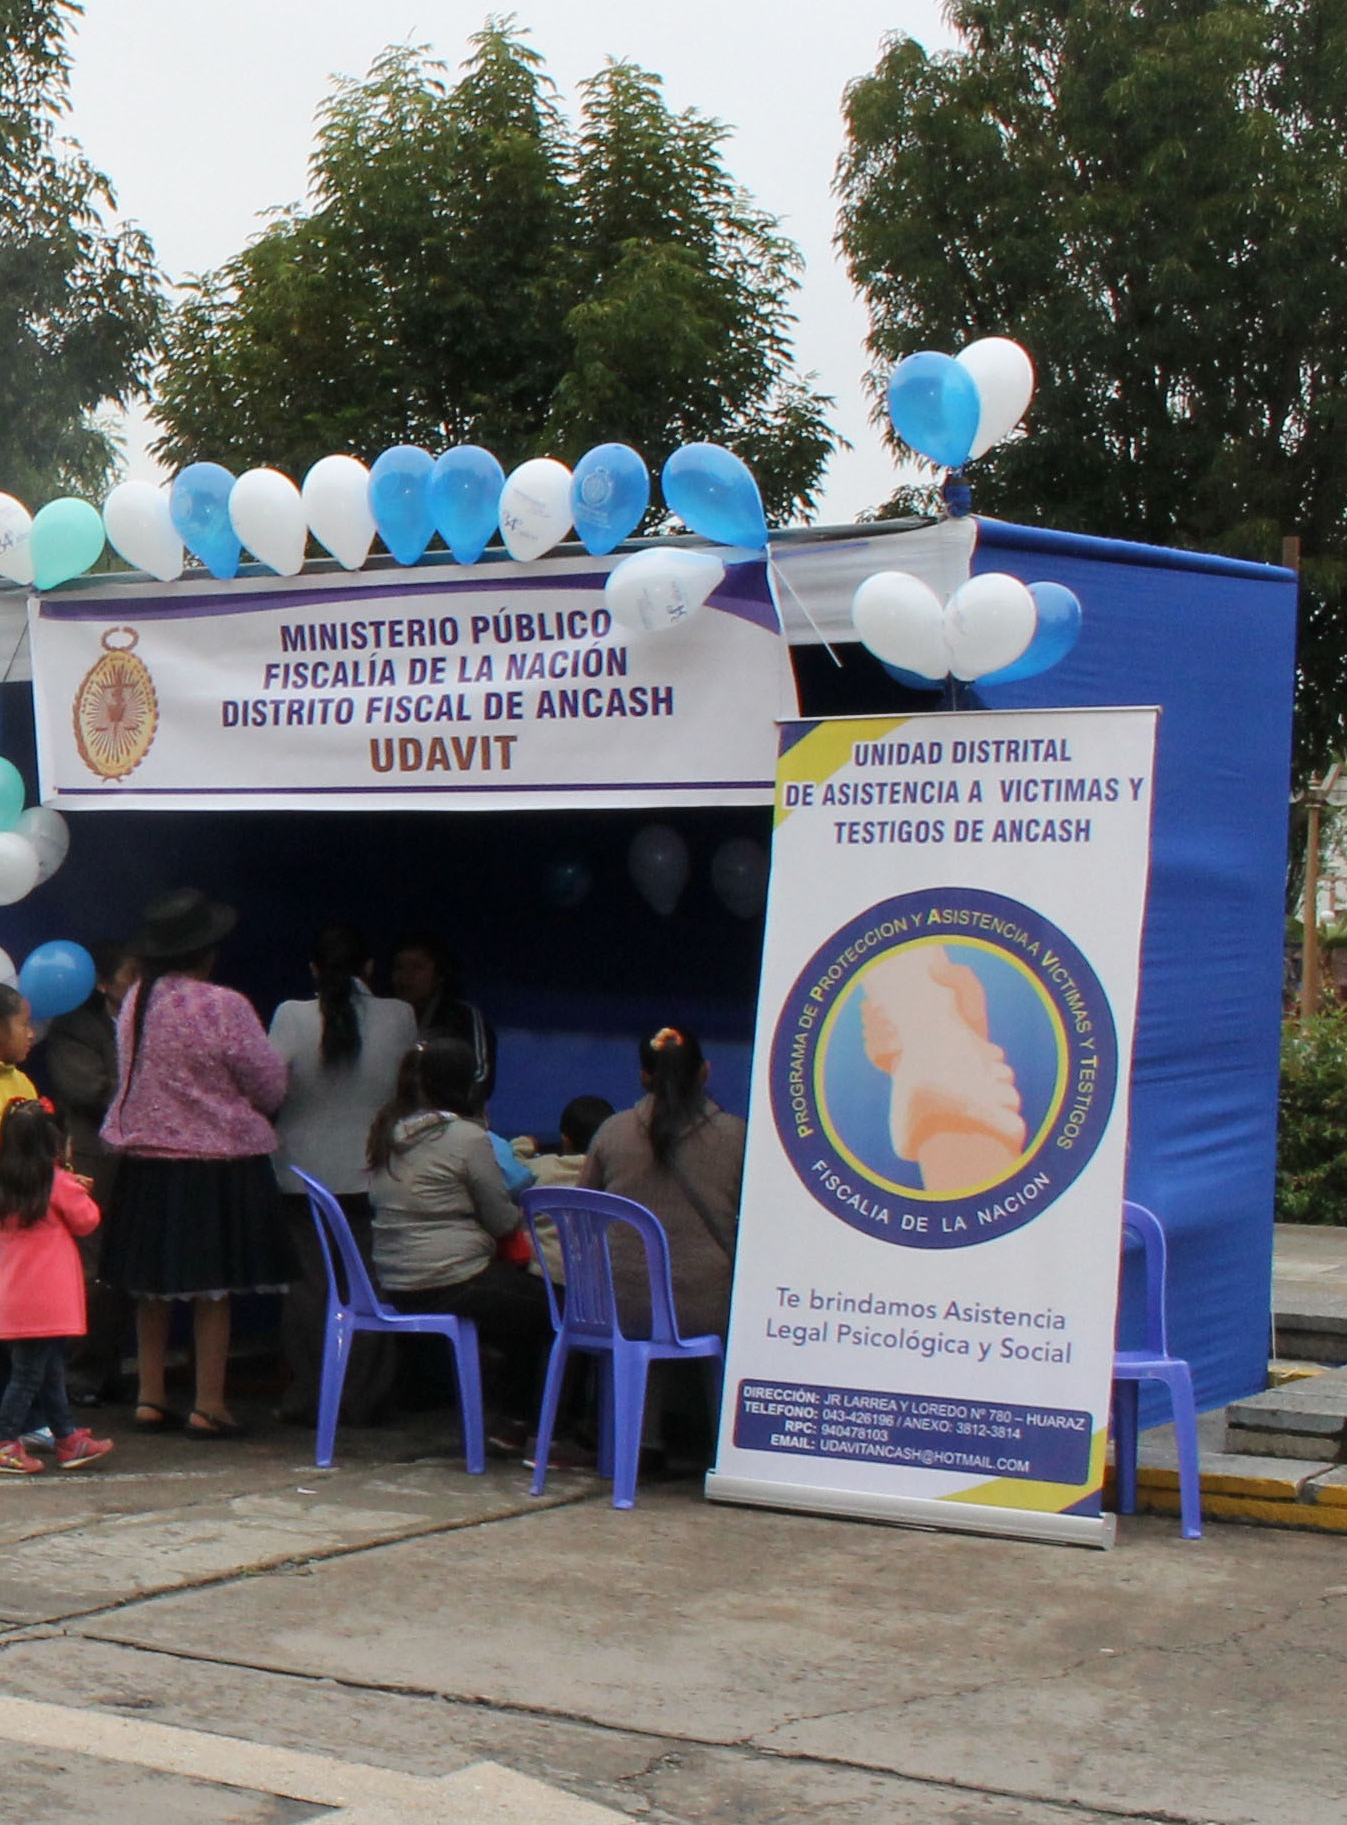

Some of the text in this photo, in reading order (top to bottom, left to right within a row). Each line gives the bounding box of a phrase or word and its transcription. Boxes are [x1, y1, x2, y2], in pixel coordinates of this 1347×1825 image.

[280, 616, 460, 653] MINISTERIO
[471, 606, 612, 644] PÚBLICO
[263, 641, 628, 691] FISCALÍA DE LA NACIÓN
[222, 686, 674, 728] DISTRITO FISCAL DE ANCASH
[369, 735, 518, 773] UDAVIT
[855, 739, 1072, 767] UNIDAD DISTRITAL
[785, 777, 1144, 807] DE ASISTENCIA A VICTIMAS Y
[833, 818, 1092, 845] TESTIGOS DE ANCASH
[789, 908, 1098, 1150] PROGRAMA DE PROTECCION Y ASISTENCIA A VICTIMAS Y TESTIGOS
[811, 1159, 1051, 1232] FISCALIA DE LA NACION
[776, 1287, 1066, 1331] Te brindamos Asistencia
[766, 1318, 1072, 1364] Legal Psicológica y Social
[743, 1385, 820, 1404] DIRECCIÓN:
[824, 1394, 841, 1407] JR
[844, 1395, 898, 1411] LARREA
[897, 1401, 909, 1413] Y
[912, 1402, 967, 1418] LOREDO
[989, 1410, 1012, 1423] 780
[1026, 1413, 1085, 1431] HUARAZ
[744, 1402, 818, 1419] TELEFONO:
[903, 1416, 953, 1433] ANEXO:
[785, 1420, 817, 1434] RPC:
[771, 1434, 1030, 1472] EMAIL: UDAVITANCASH@HOTMAIL.COM
